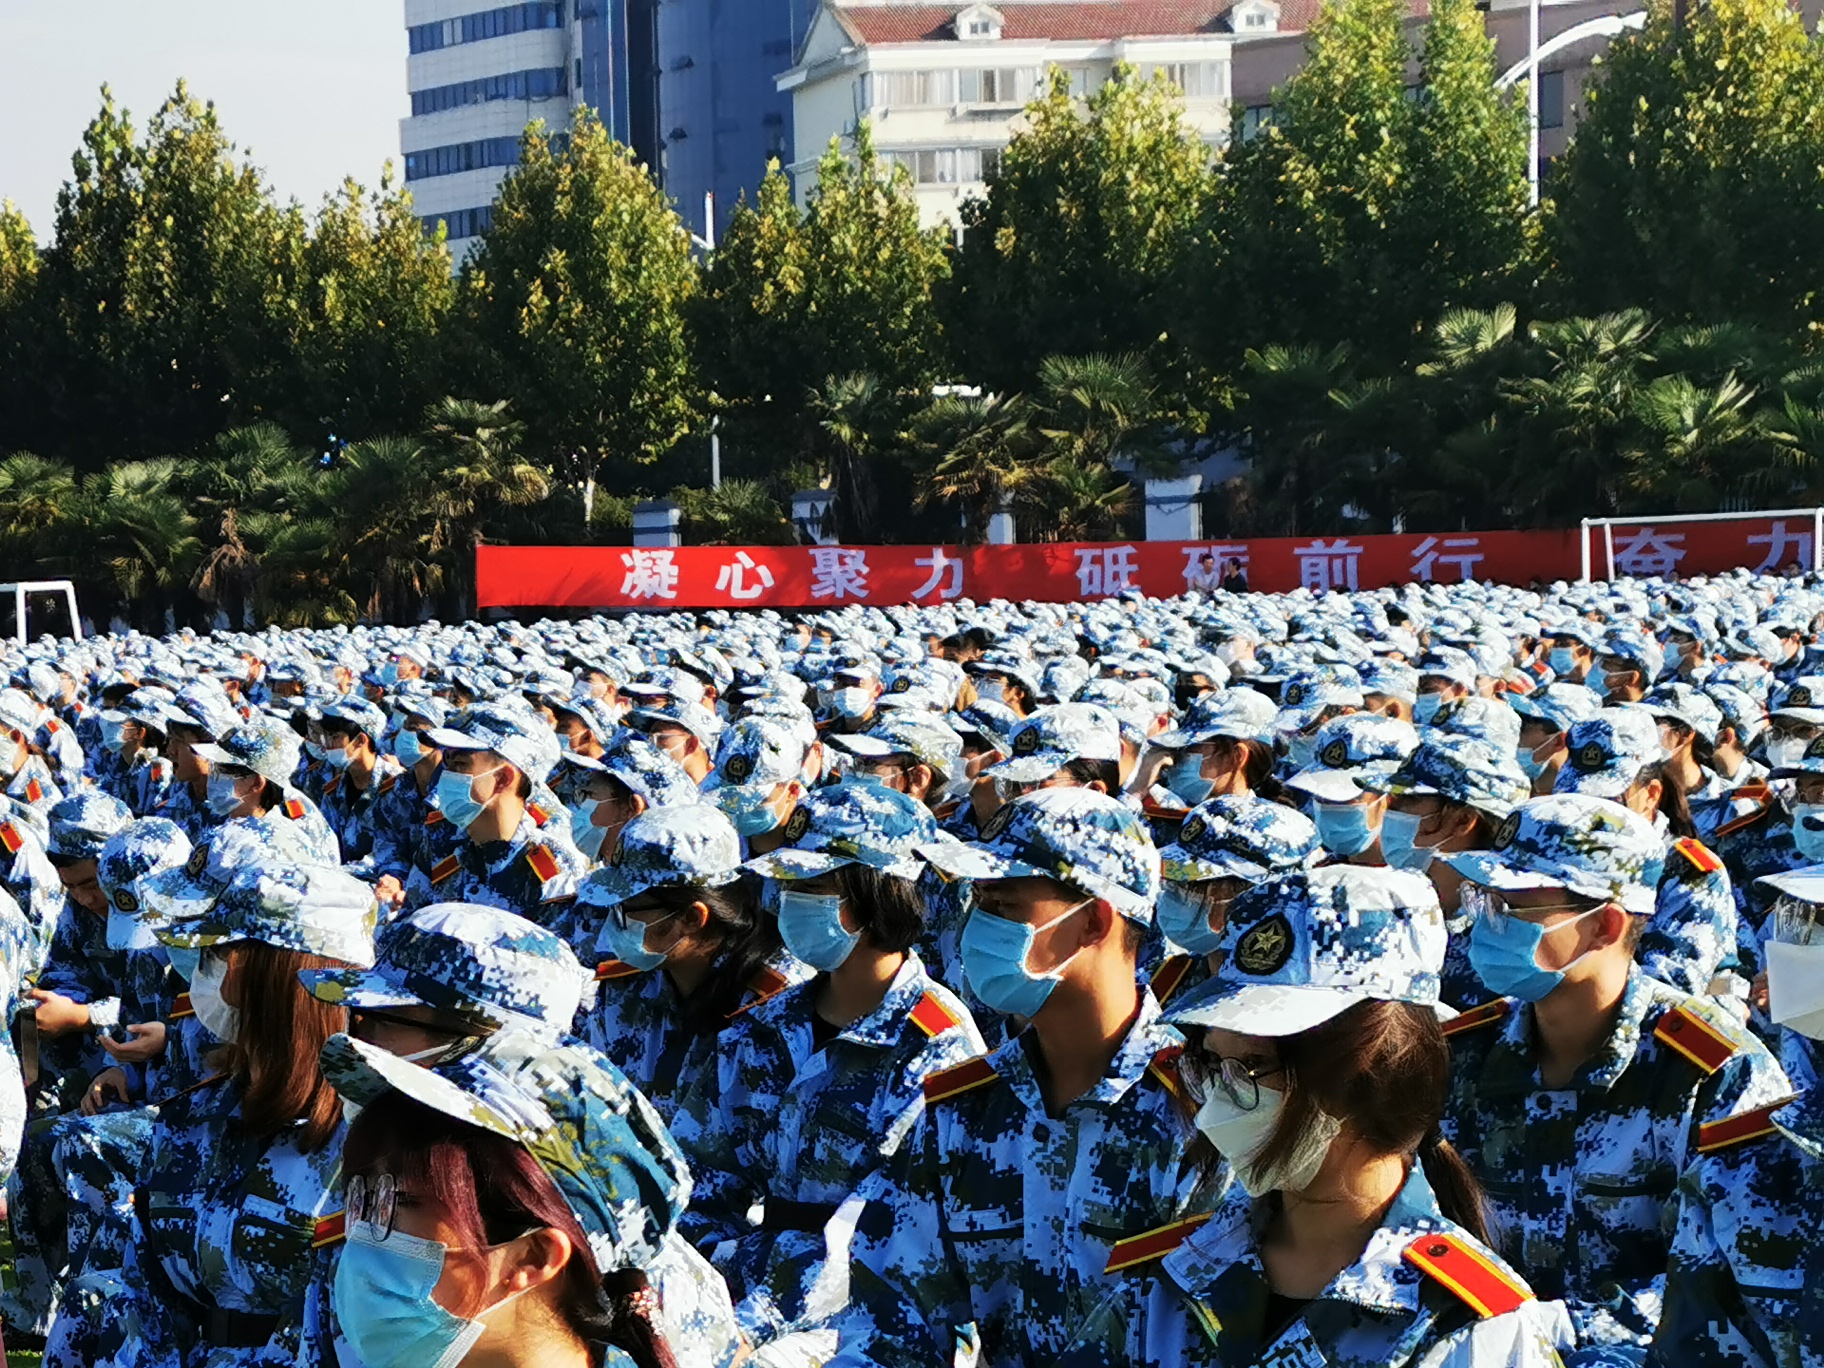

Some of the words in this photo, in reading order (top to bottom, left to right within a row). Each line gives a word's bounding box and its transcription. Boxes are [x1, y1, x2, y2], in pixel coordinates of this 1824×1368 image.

[620, 548, 964, 599] 凝心聚力
[1614, 521, 1812, 580] 奋力
